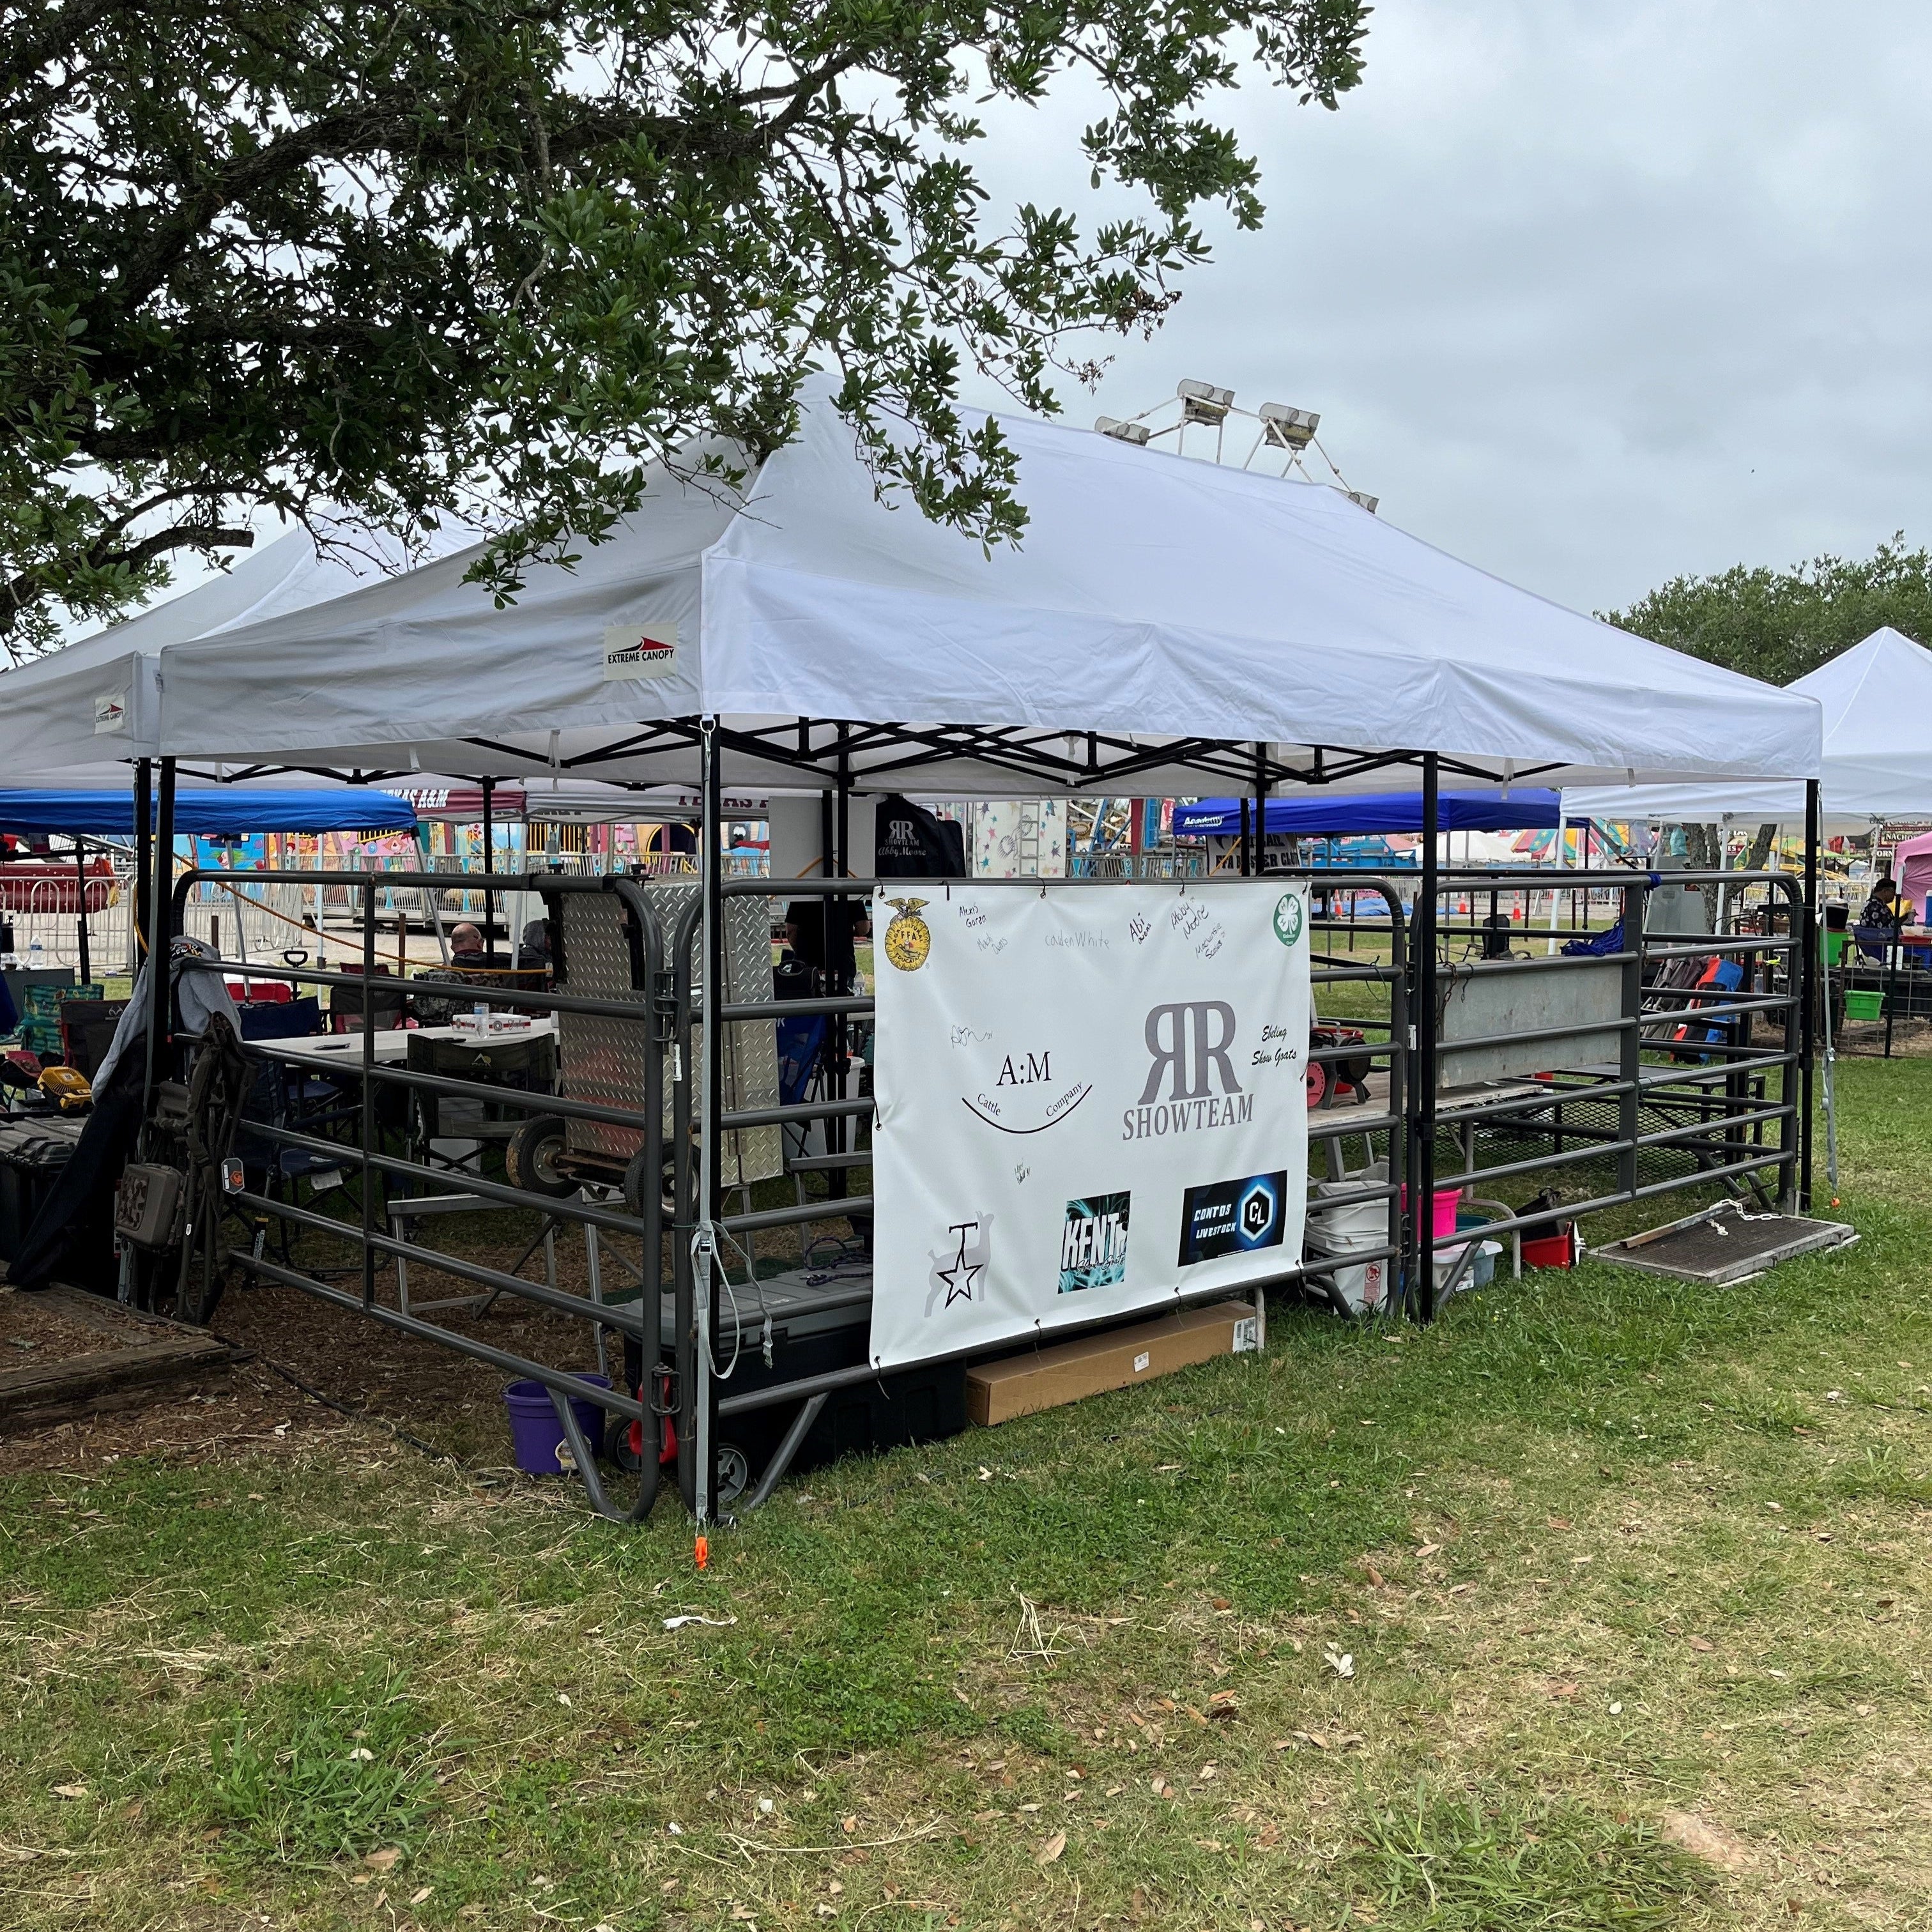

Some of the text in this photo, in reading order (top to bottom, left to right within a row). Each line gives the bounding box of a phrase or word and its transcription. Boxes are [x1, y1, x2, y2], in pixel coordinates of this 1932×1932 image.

[608, 649, 675, 664] EXTREME CANOPY
[417, 789, 450, 808] A&M
[1885, 832, 1916, 841] NACHO
[878, 846, 899, 857] Abby
[1129, 912, 1145, 942] Abi
[1183, 905, 1209, 940] Moore
[893, 924, 923, 944] AGRICULTURAL
[901, 931, 917, 941] FFA
[1075, 930, 1110, 950] White
[1261, 1025, 1288, 1042] Ebeling
[1251, 1047, 1298, 1068] Show Goats
[995, 1051, 1052, 1086] A:M
[977, 1081, 1083, 1117] Cattle Company
[1123, 1094, 1254, 1140] SHOWTEAM
[1193, 1204, 1232, 1222] CONTOS
[1248, 1201, 1265, 1225] CL
[1195, 1222, 1237, 1239] LIVESTOCK
[1061, 1213, 1120, 1271] KENT
